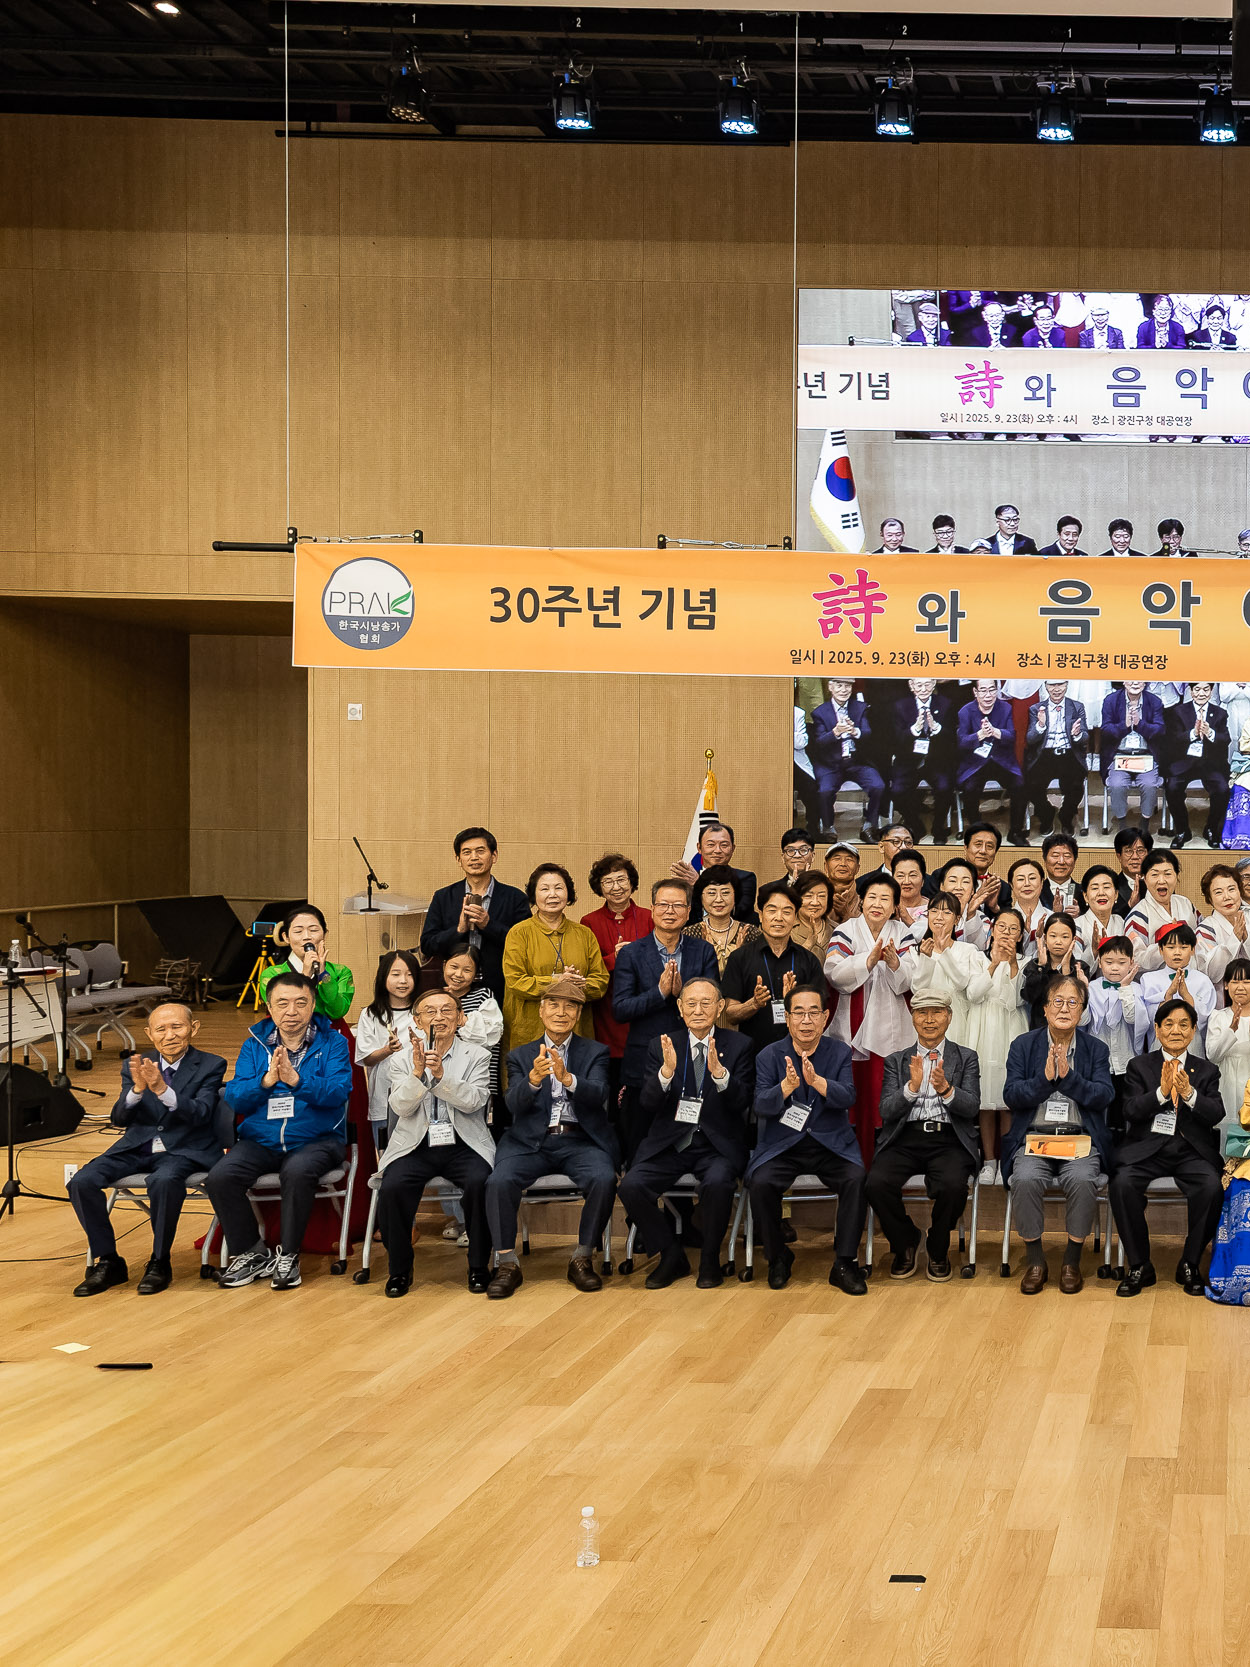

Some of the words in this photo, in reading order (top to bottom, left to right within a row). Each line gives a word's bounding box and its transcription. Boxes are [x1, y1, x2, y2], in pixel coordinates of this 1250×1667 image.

[412, 13, 416, 24] 1
[576, 17, 582, 28] 2
[739, 22, 744, 32] 1
[902, 25, 908, 36] 2
[1068, 28, 1072, 38] 1
[838, 371, 891, 401] 기념
[939, 411, 958, 425] 일시
[966, 413, 992, 424] 2025.
[1006, 412, 1035, 425] 23(화)
[1036, 413, 1055, 425] 오후
[1062, 413, 1079, 425] 4시
[1091, 415, 1110, 426] 장소
[1117, 415, 1154, 427] 광진구청
[1155, 415, 1193, 427] 대공연장
[488, 586, 622, 630] 30주년
[638, 587, 718, 632] 기념
[338, 619, 401, 632] 한국시낭송가
[789, 648, 816, 666] 일시
[827, 650, 868, 666] 2025.
[870, 651, 885, 667] 9.
[887, 650, 931, 669] 23(화)
[932, 651, 963, 668] 오후
[973, 651, 996, 669] 4시
[1015, 652, 1044, 669] 장소
[1053, 652, 1110, 670] 광진구청
[1112, 653, 1170, 671] 대공연장
